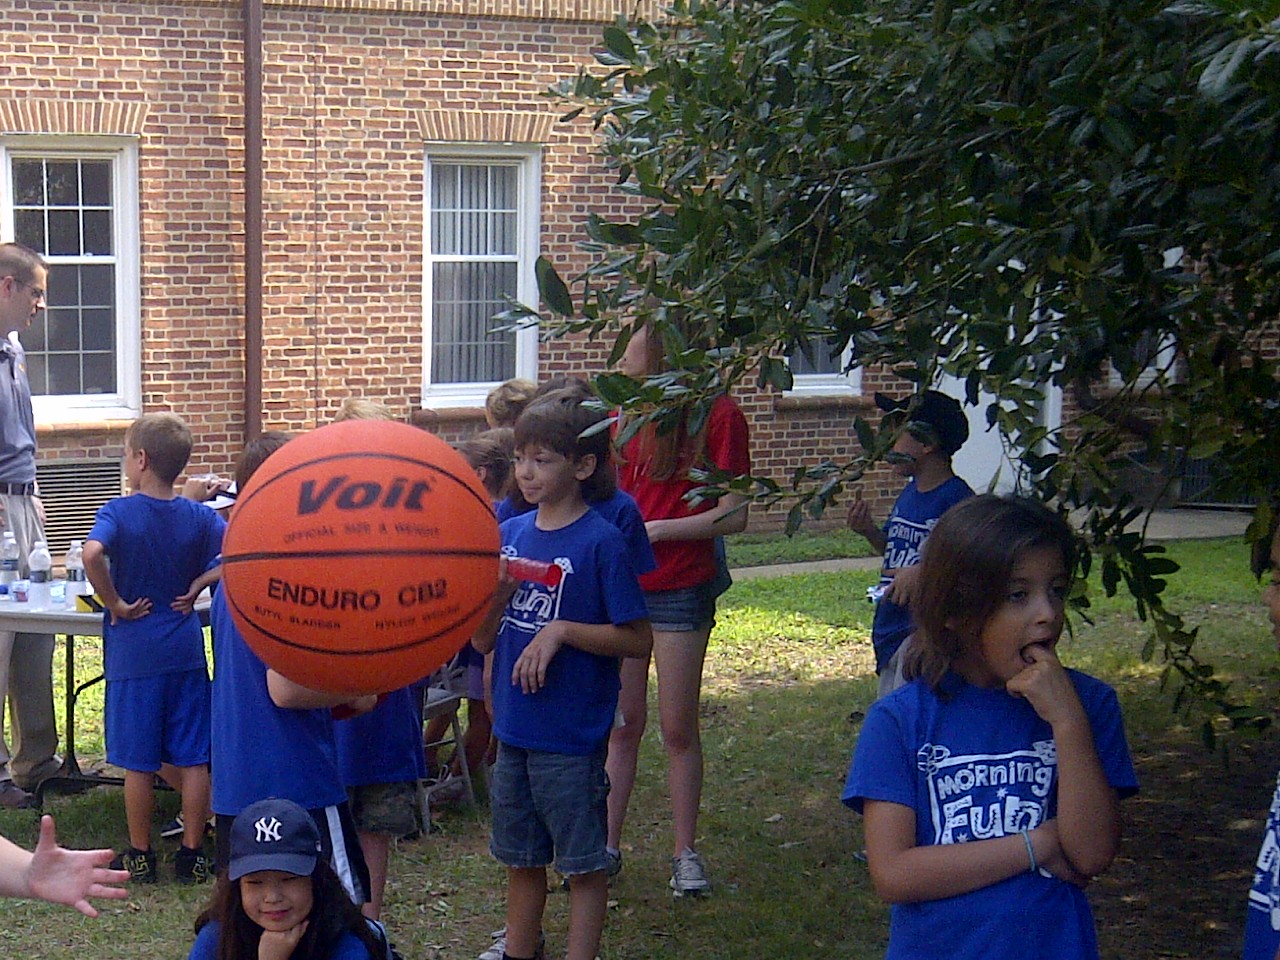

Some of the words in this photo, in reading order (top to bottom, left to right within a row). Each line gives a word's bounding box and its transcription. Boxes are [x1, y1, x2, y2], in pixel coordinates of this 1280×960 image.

[297, 475, 432, 517] Voit
[268, 577, 381, 611] ENDURO
[254, 816, 282, 842] NY
[941, 794, 1043, 845] Fun
